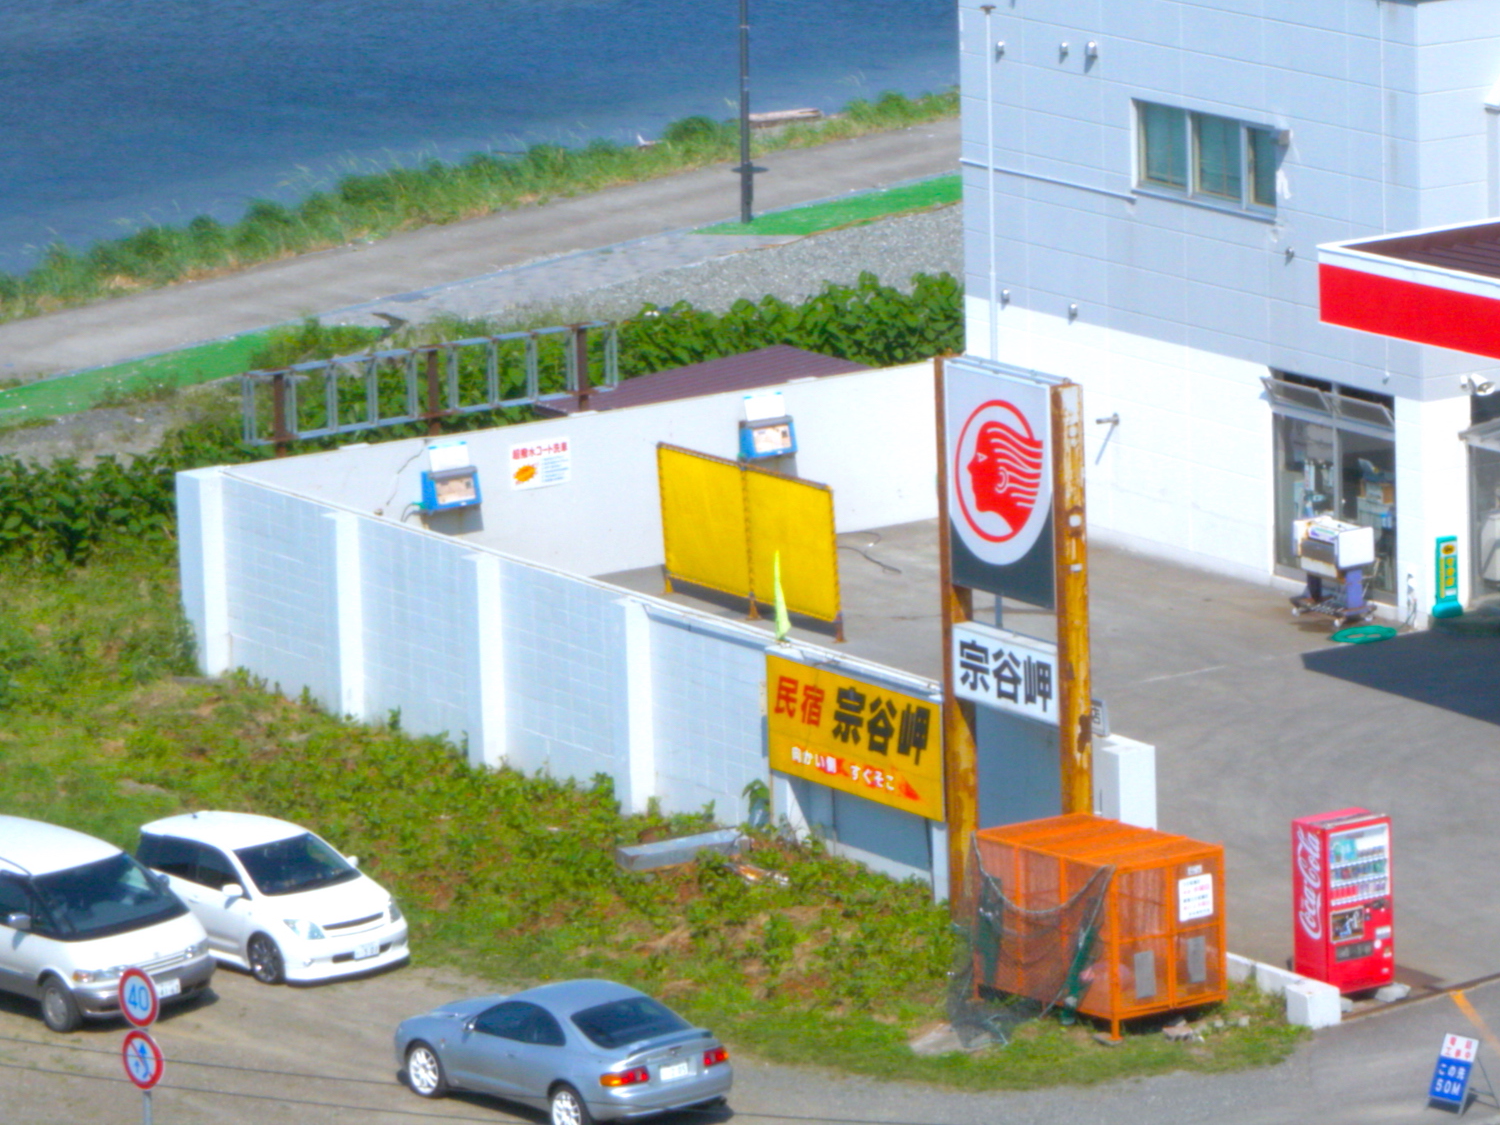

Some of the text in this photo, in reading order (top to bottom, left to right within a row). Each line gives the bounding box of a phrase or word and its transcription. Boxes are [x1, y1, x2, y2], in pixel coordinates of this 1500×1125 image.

[959, 639, 1053, 713] 宗谷岬
[774, 675, 931, 766] 民宿 宗谷岬
[850, 764, 895, 791] すぐそこ
[128, 984, 149, 1012] 40
